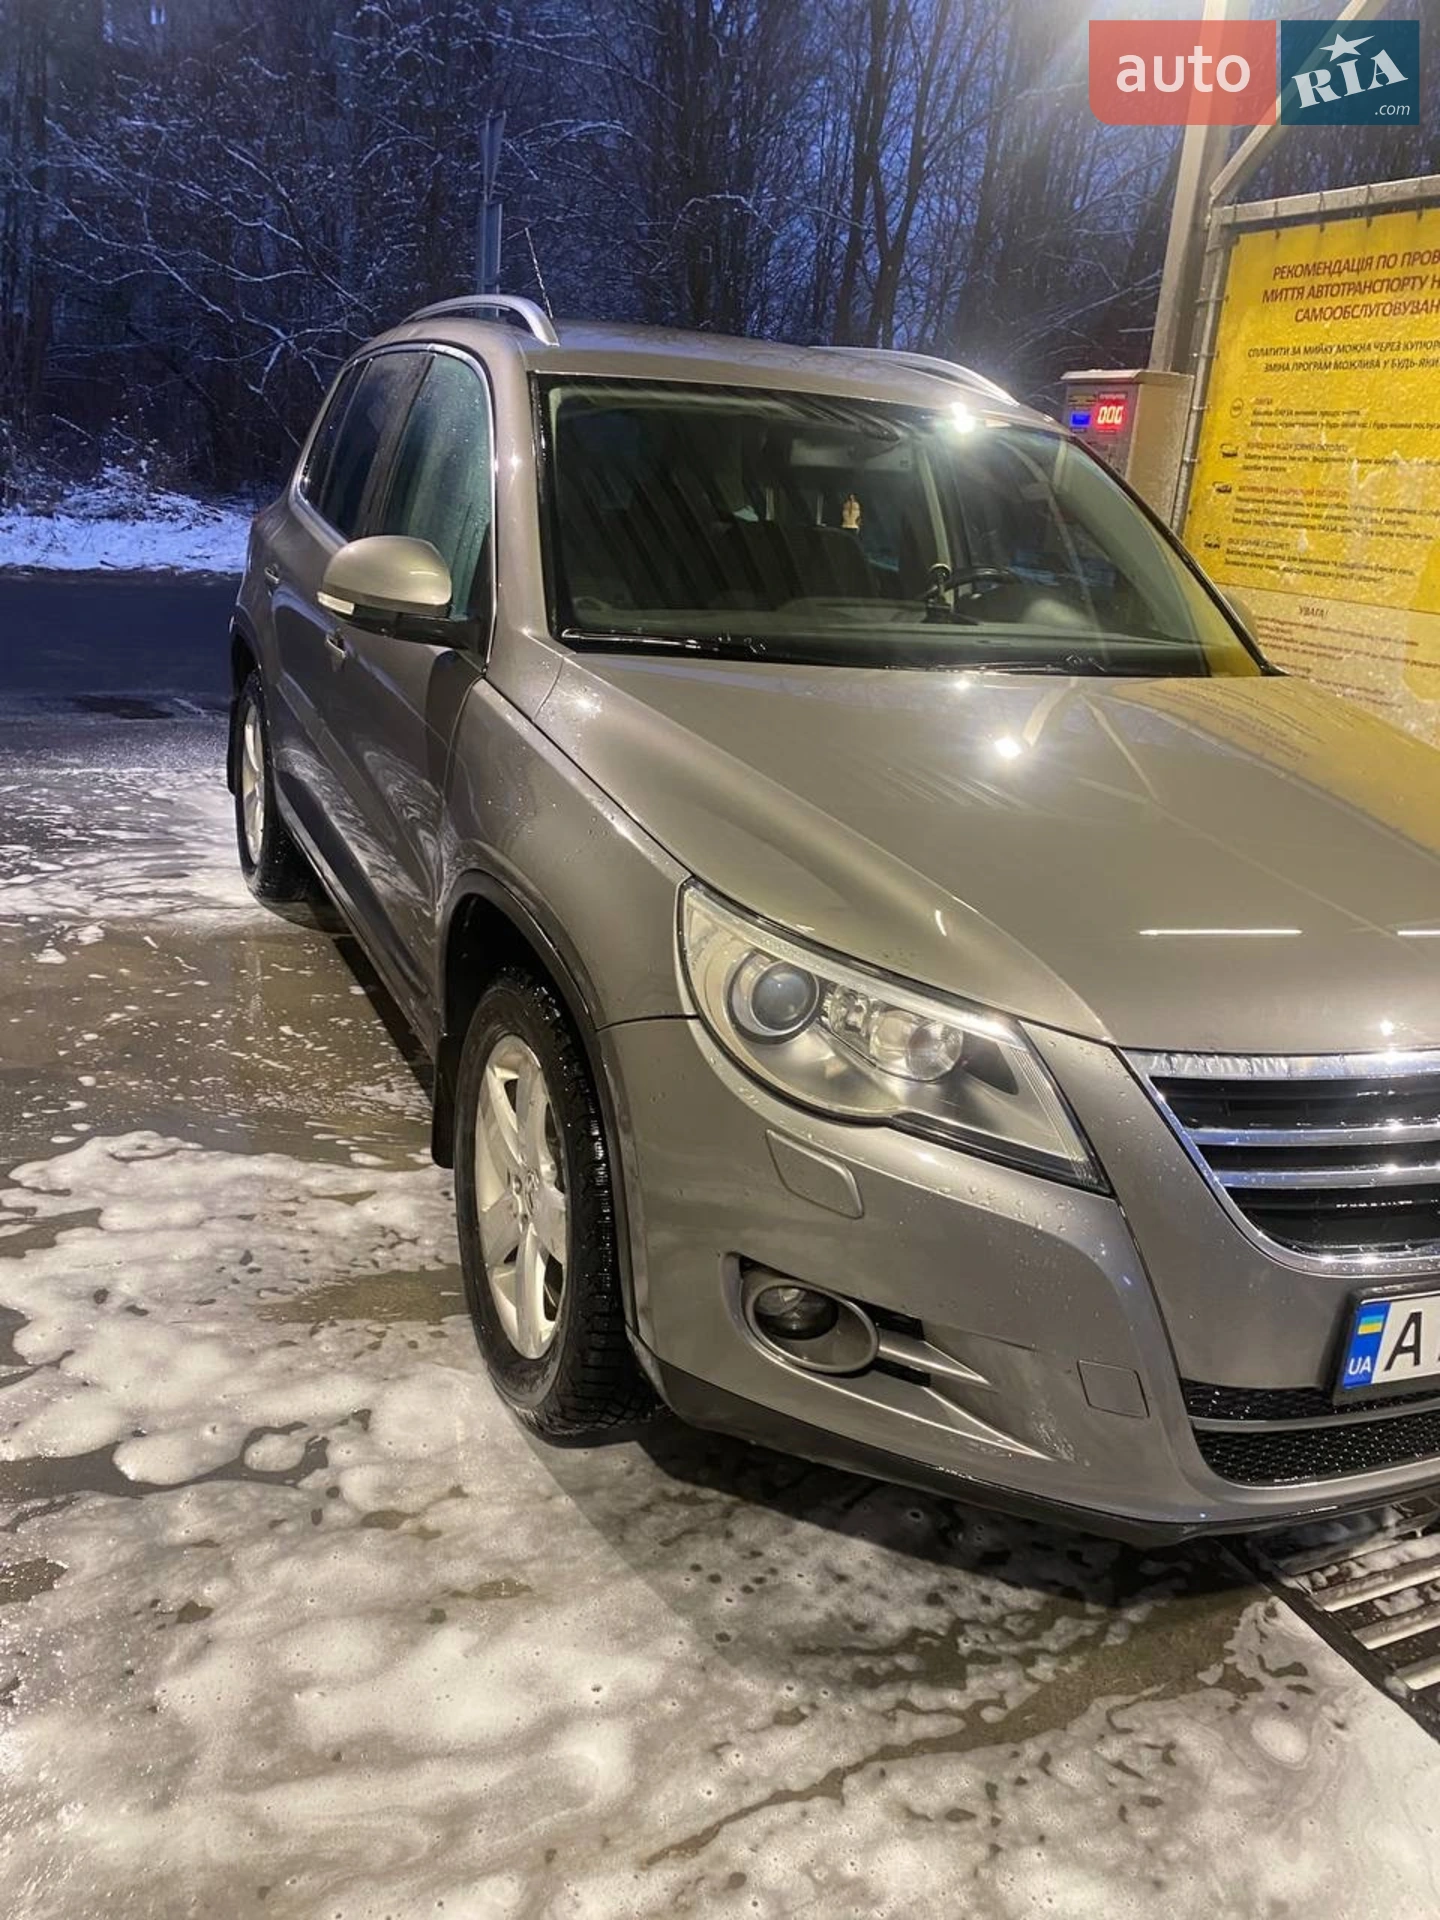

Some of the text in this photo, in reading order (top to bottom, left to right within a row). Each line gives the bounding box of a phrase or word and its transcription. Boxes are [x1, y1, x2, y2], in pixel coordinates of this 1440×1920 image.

[1272, 256, 1374, 281] РЕКОМЕНДАЦІЯ
[1376, 253, 1398, 270] ПО
[1262, 287, 1305, 303] МИТТЯ
[1306, 275, 1429, 299] АВТОТРАНСПОРТУ
[1383, 1310, 1440, 1372] A
[1348, 1355, 1372, 1375] UA
